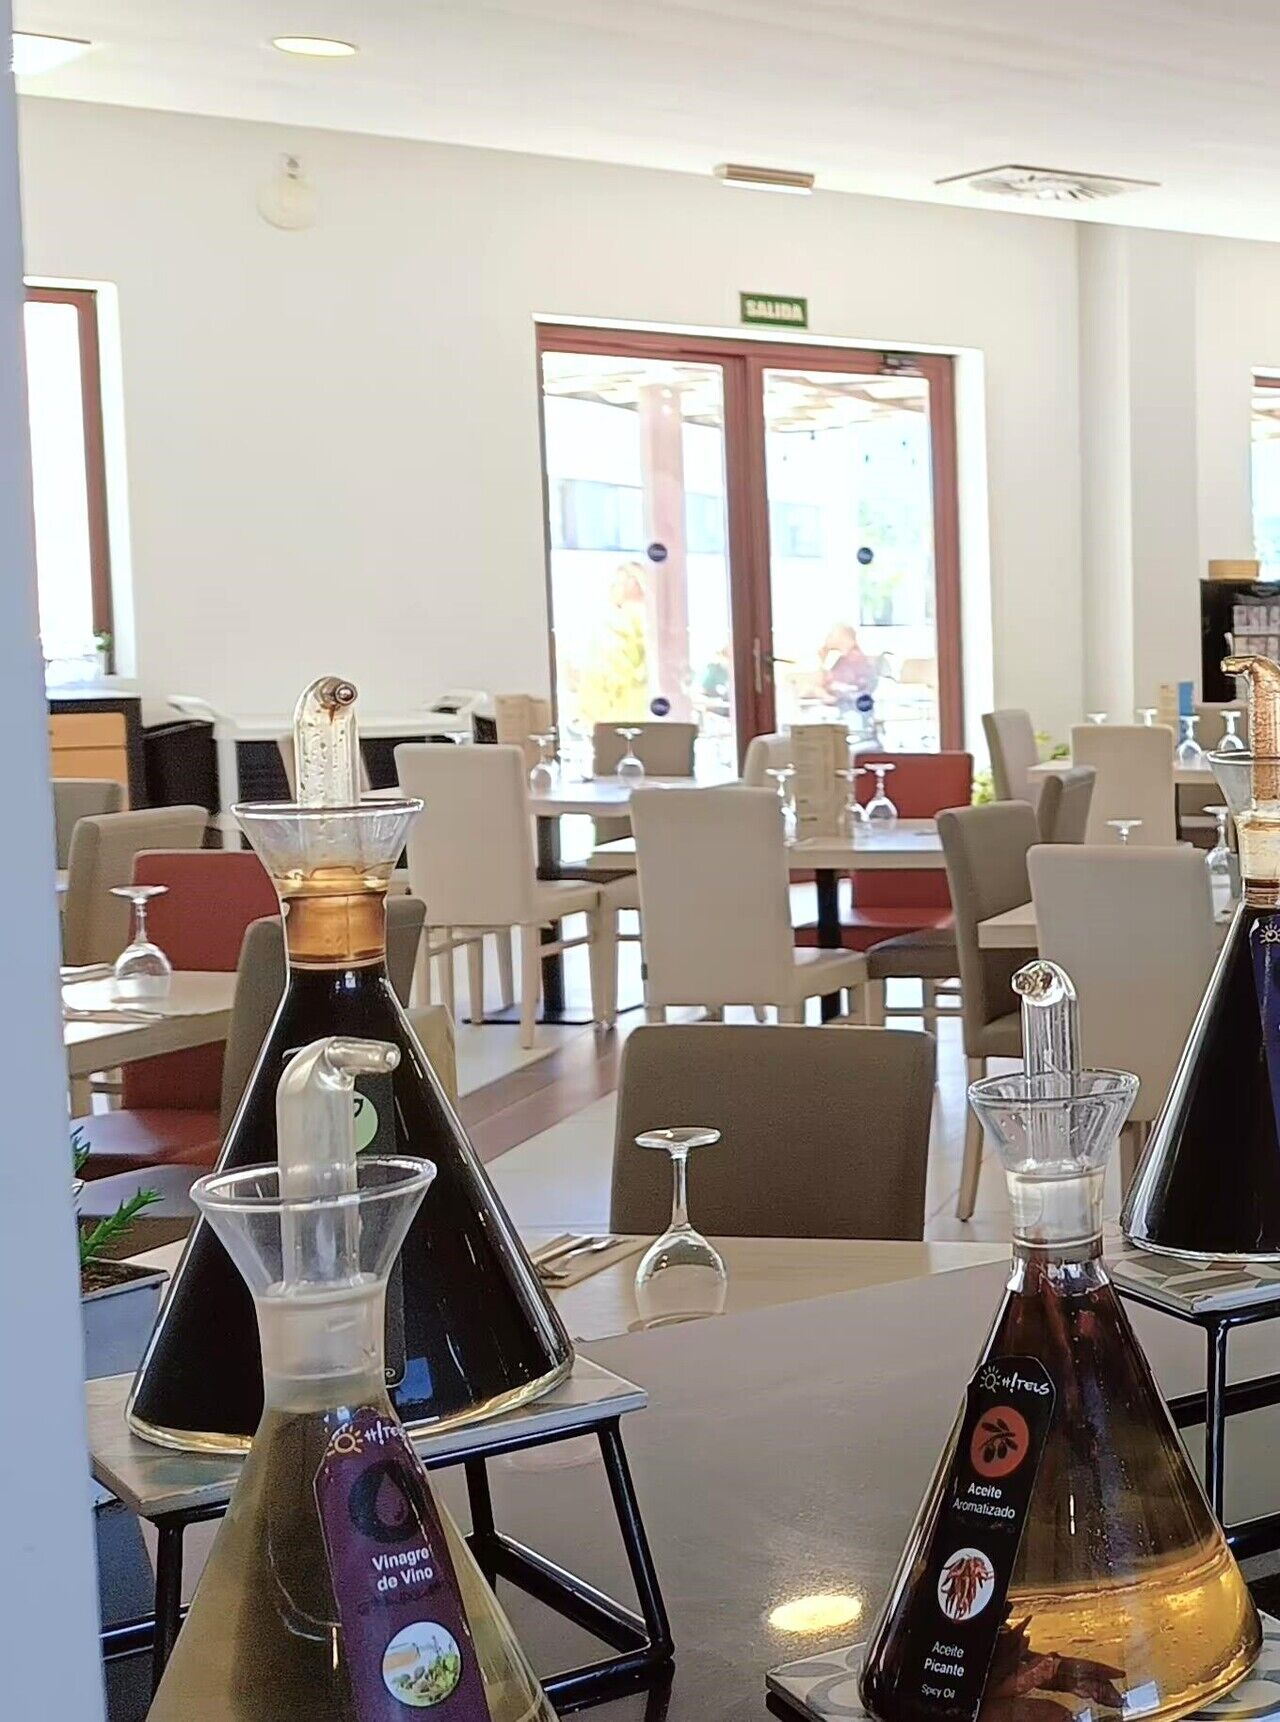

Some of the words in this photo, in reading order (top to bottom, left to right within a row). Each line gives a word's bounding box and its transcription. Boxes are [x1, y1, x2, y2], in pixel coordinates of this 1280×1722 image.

[745, 299, 804, 321] SALIDA
[967, 1482, 1003, 1499] Aceite
[952, 1497, 1016, 1520] Aromatizado
[371, 1547, 430, 1572] Vinagre
[377, 1575, 398, 1592] de
[400, 1566, 434, 1586] Vino
[931, 1640, 965, 1659] Aceite
[923, 1657, 965, 1677] Picante
[921, 1683, 942, 1698] Spicy
[943, 1687, 956, 1698] Oil
